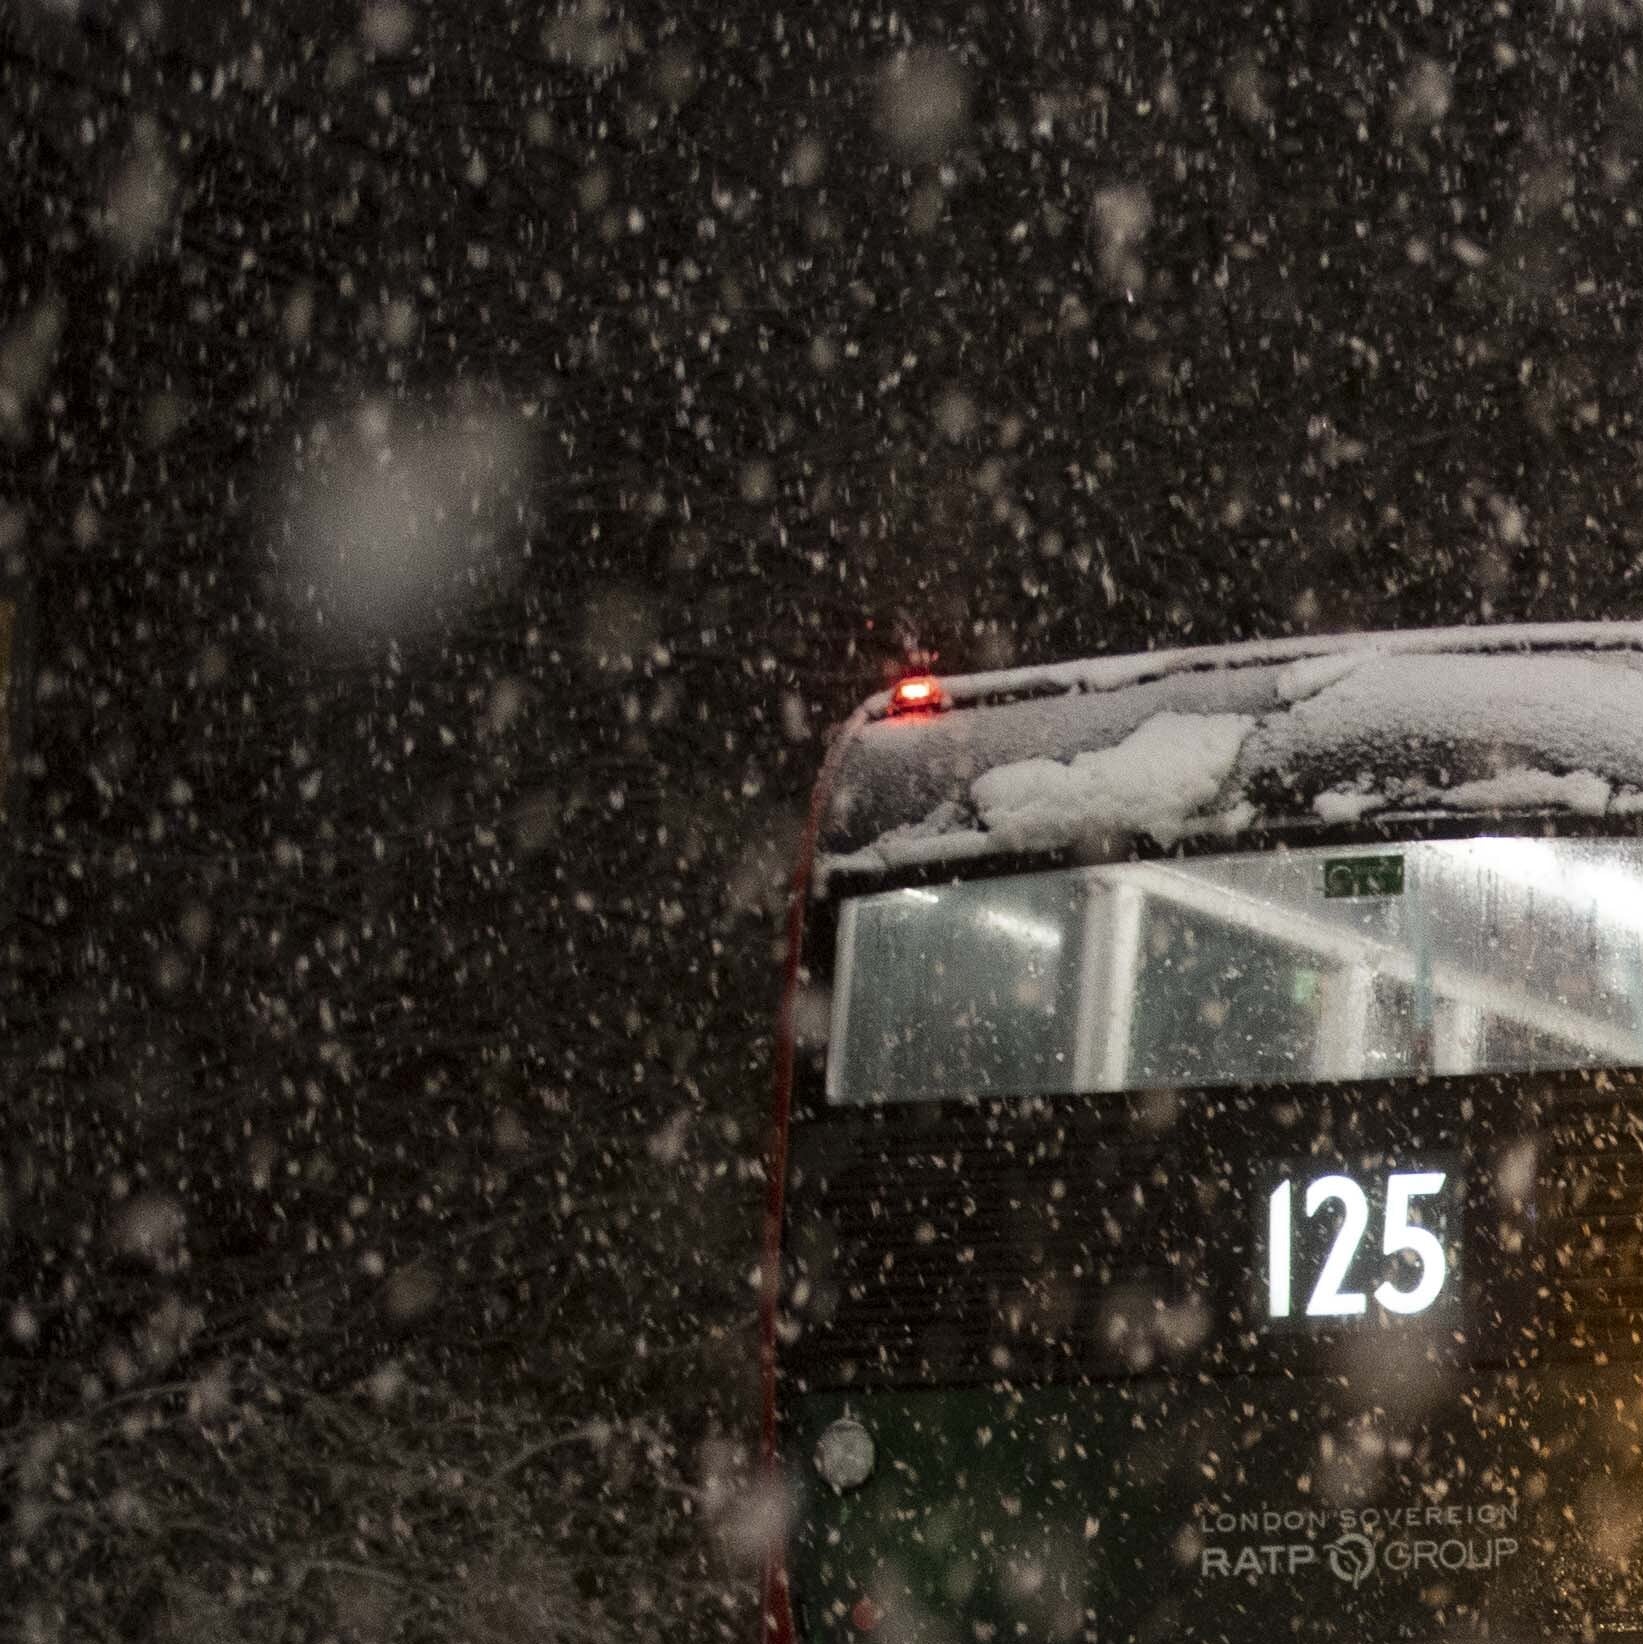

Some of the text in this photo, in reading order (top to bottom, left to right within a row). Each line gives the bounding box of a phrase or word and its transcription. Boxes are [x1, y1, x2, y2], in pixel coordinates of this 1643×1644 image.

[1270, 1173, 1446, 1317] 125
[1202, 1505, 1518, 1532] LONDON SOVEREIGN
[1202, 1538, 1518, 1577] RATP GROUP
